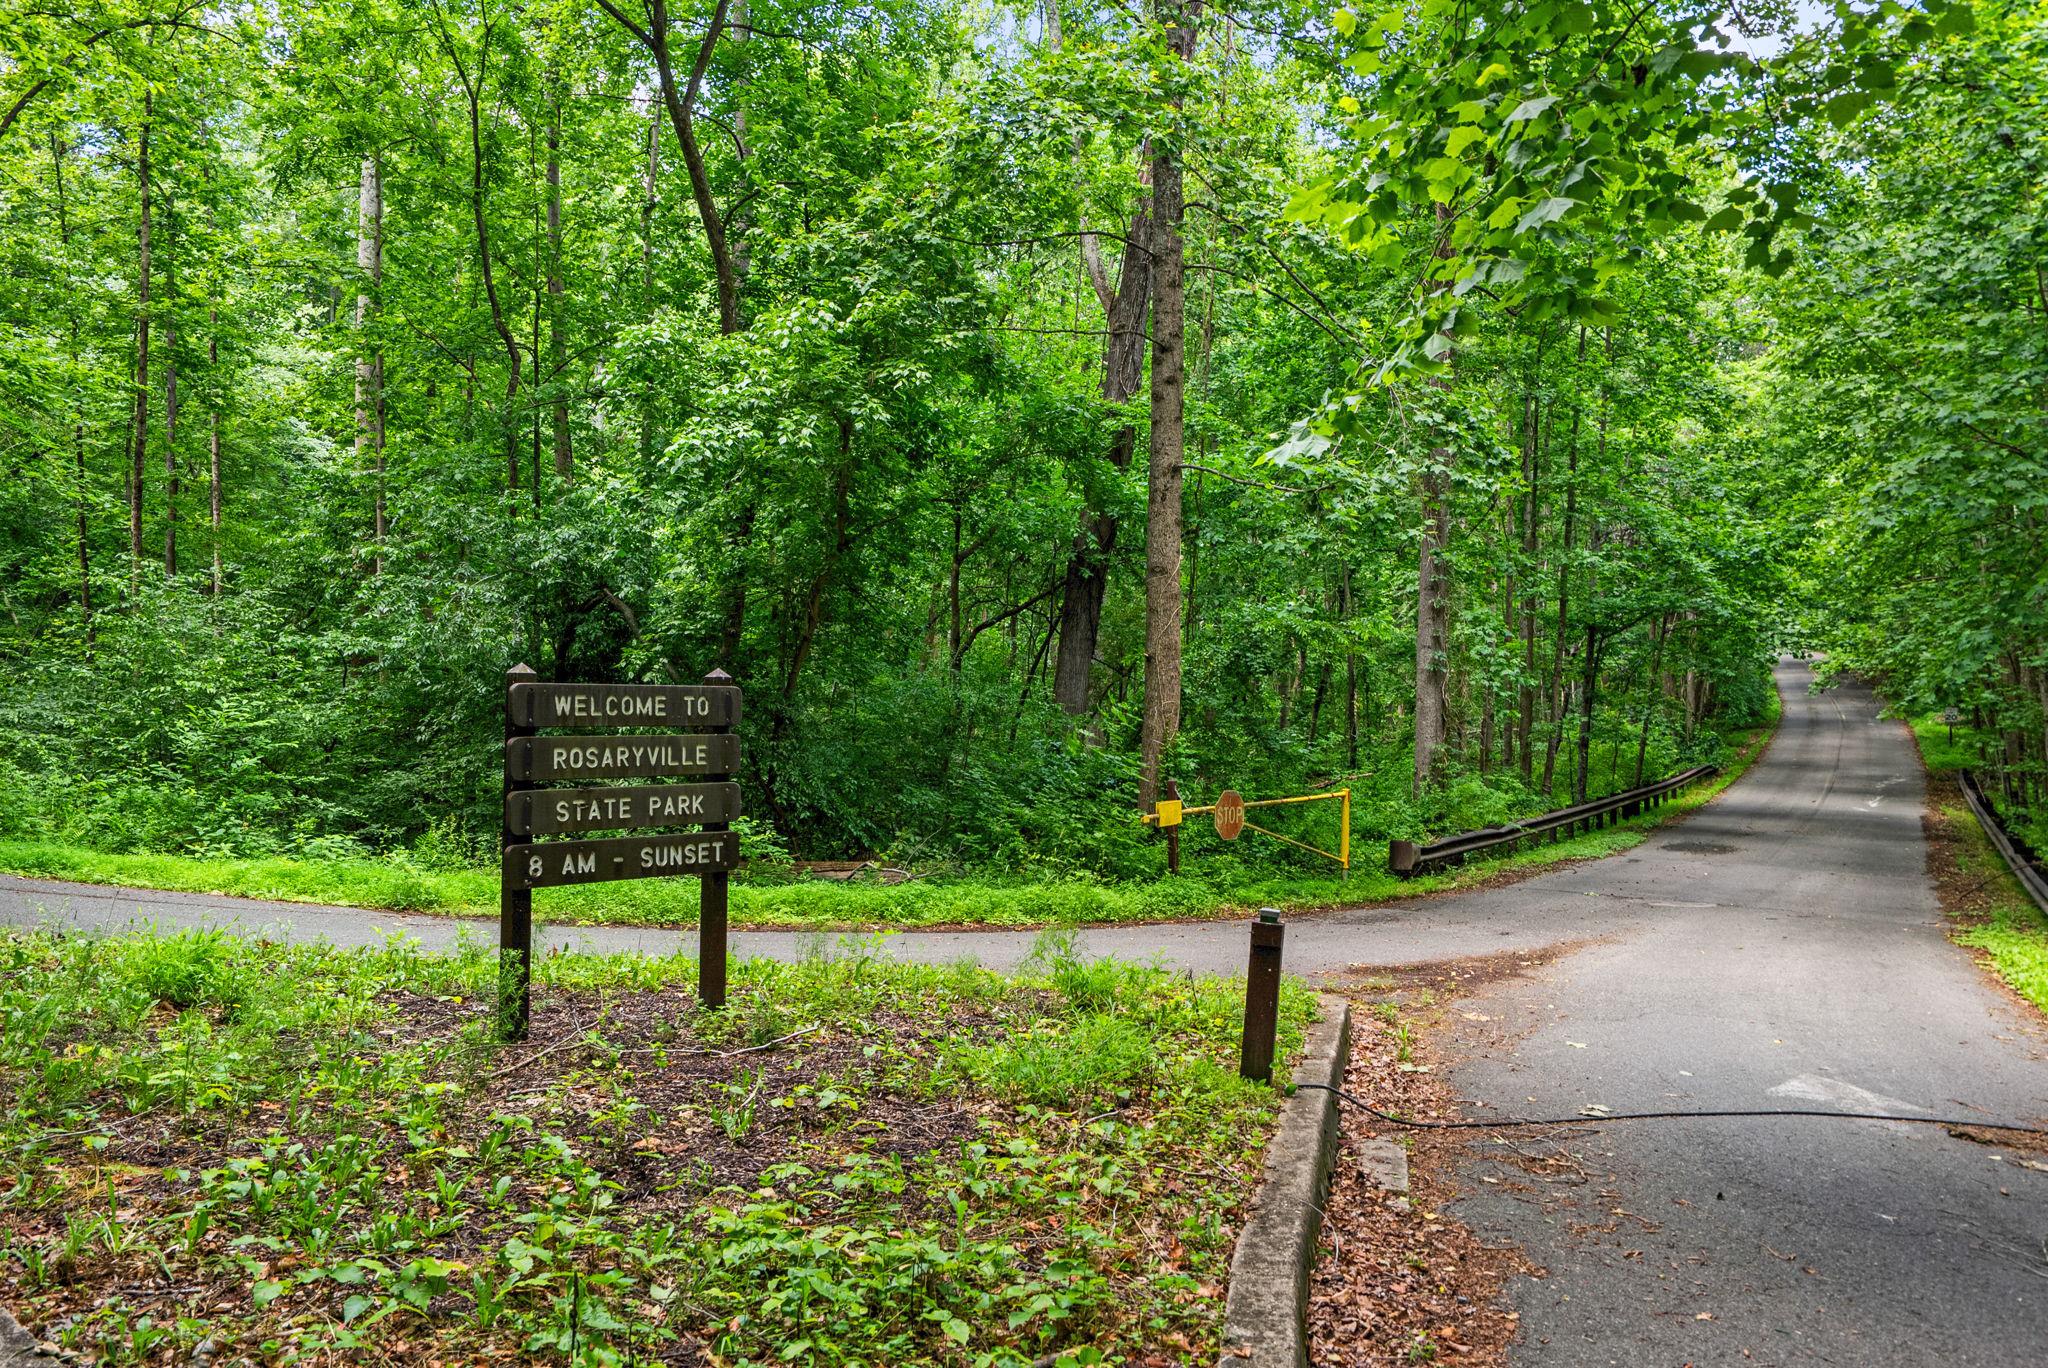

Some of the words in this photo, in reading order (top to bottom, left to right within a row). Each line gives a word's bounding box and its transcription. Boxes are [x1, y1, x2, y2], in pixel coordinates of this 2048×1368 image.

[554, 695, 667, 717] WELCOME
[683, 695, 710, 716] TO
[553, 745, 708, 770] ROSARYVILLE
[556, 797, 632, 822] STATE
[649, 794, 705, 817] PARK
[1217, 806, 1243, 824] STOP
[528, 855, 543, 878] 8
[562, 851, 596, 875] AM
[640, 842, 724, 868] SUNSET
